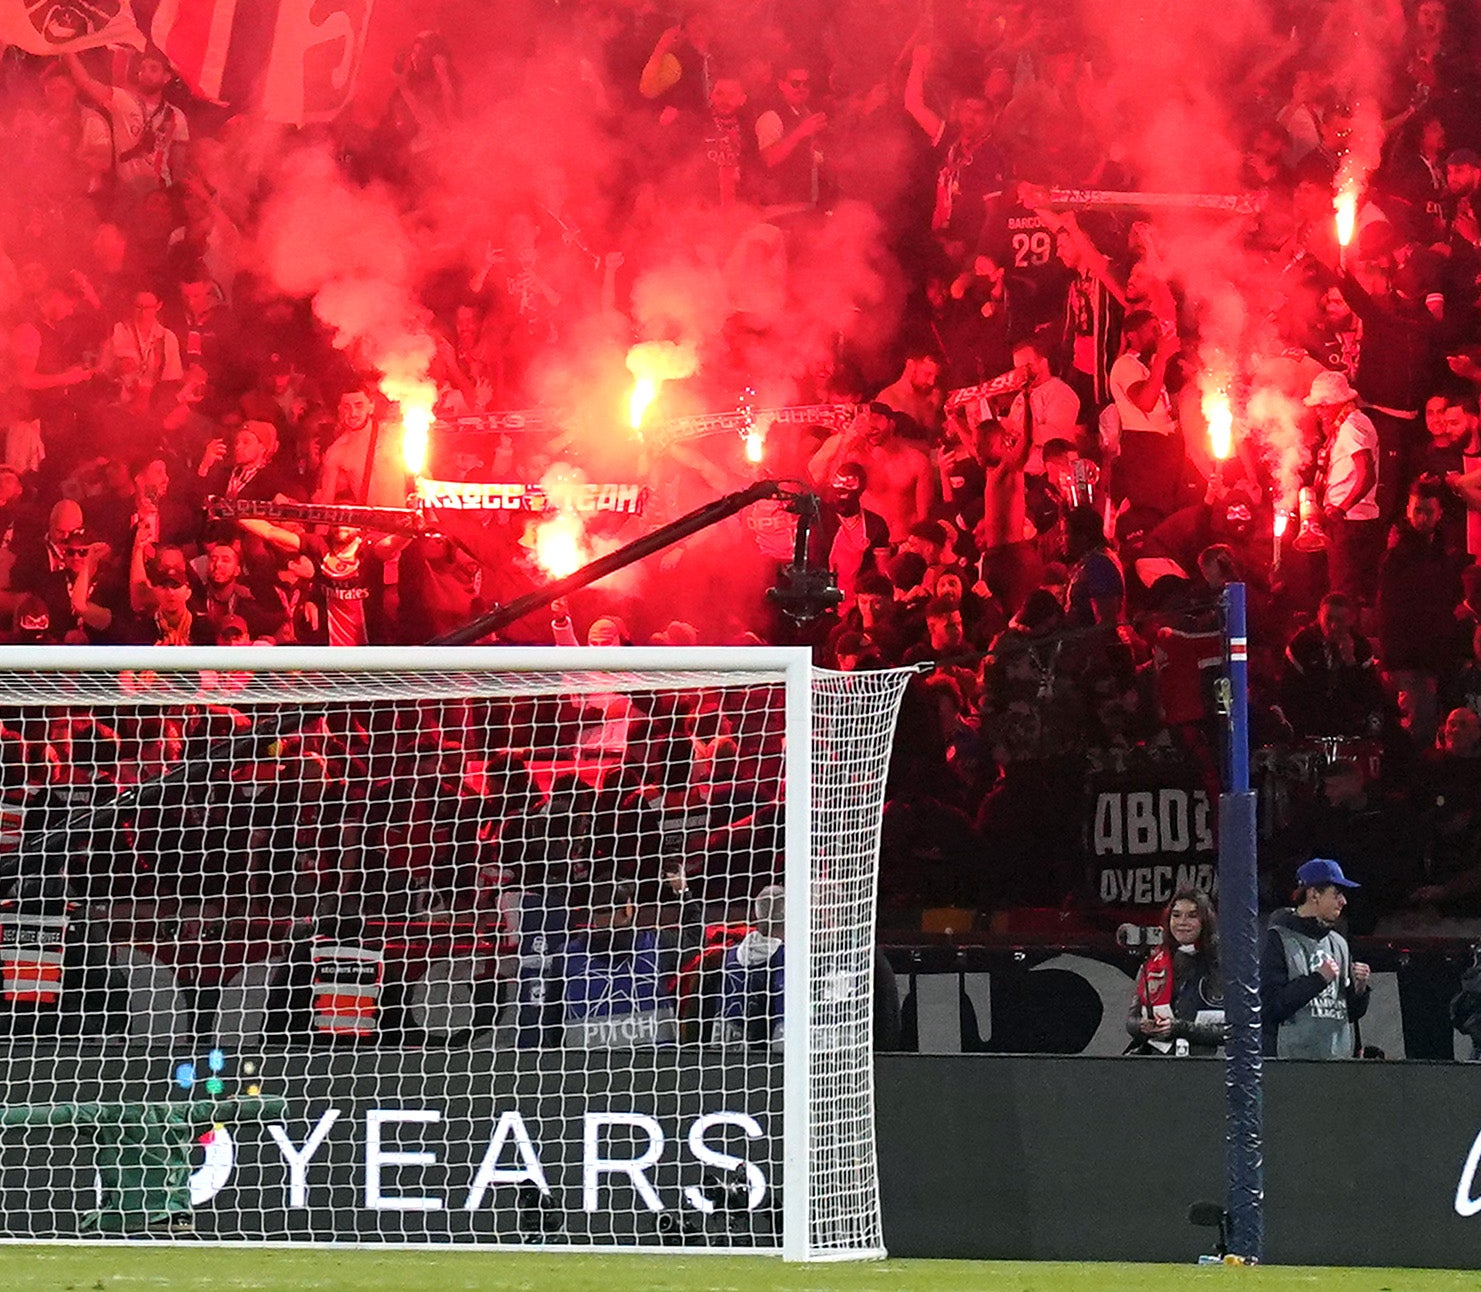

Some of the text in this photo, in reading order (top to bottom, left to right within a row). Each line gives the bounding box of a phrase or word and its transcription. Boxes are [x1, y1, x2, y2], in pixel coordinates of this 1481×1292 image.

[1011, 232, 1051, 267] 29
[585, 1018, 659, 1045] PITCH
[267, 1108, 766, 1214] YEARS
